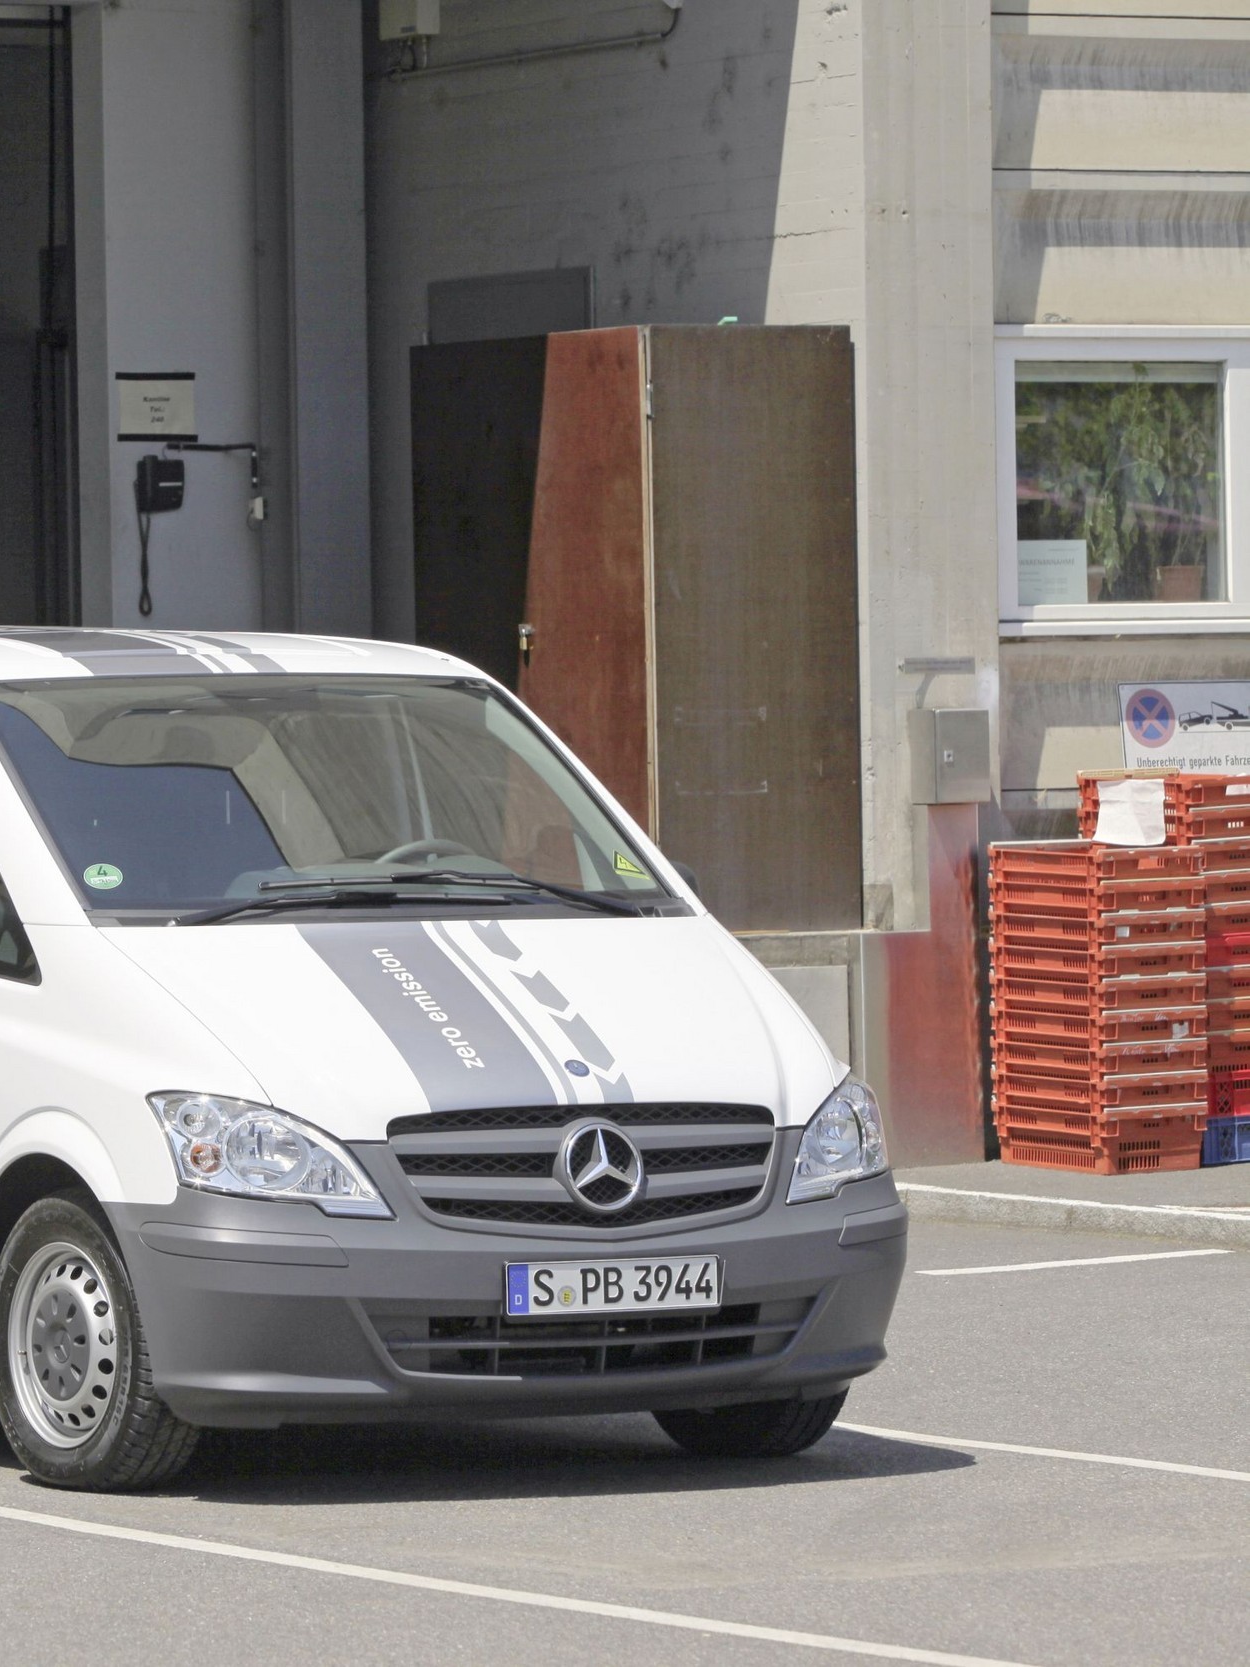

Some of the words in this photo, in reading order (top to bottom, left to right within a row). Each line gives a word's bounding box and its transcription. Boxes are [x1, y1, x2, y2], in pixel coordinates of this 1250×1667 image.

[1136, 755, 1187, 769] Unberechtigt
[1189, 755, 1223, 769] geparkte
[97, 865, 108, 877] 4
[371, 947, 449, 1023] emission
[441, 1026, 486, 1069] zero
[533, 1269, 555, 1307] S
[580, 1266, 625, 1305] PB
[632, 1262, 714, 1303] 3944
[514, 1294, 523, 1306] D
